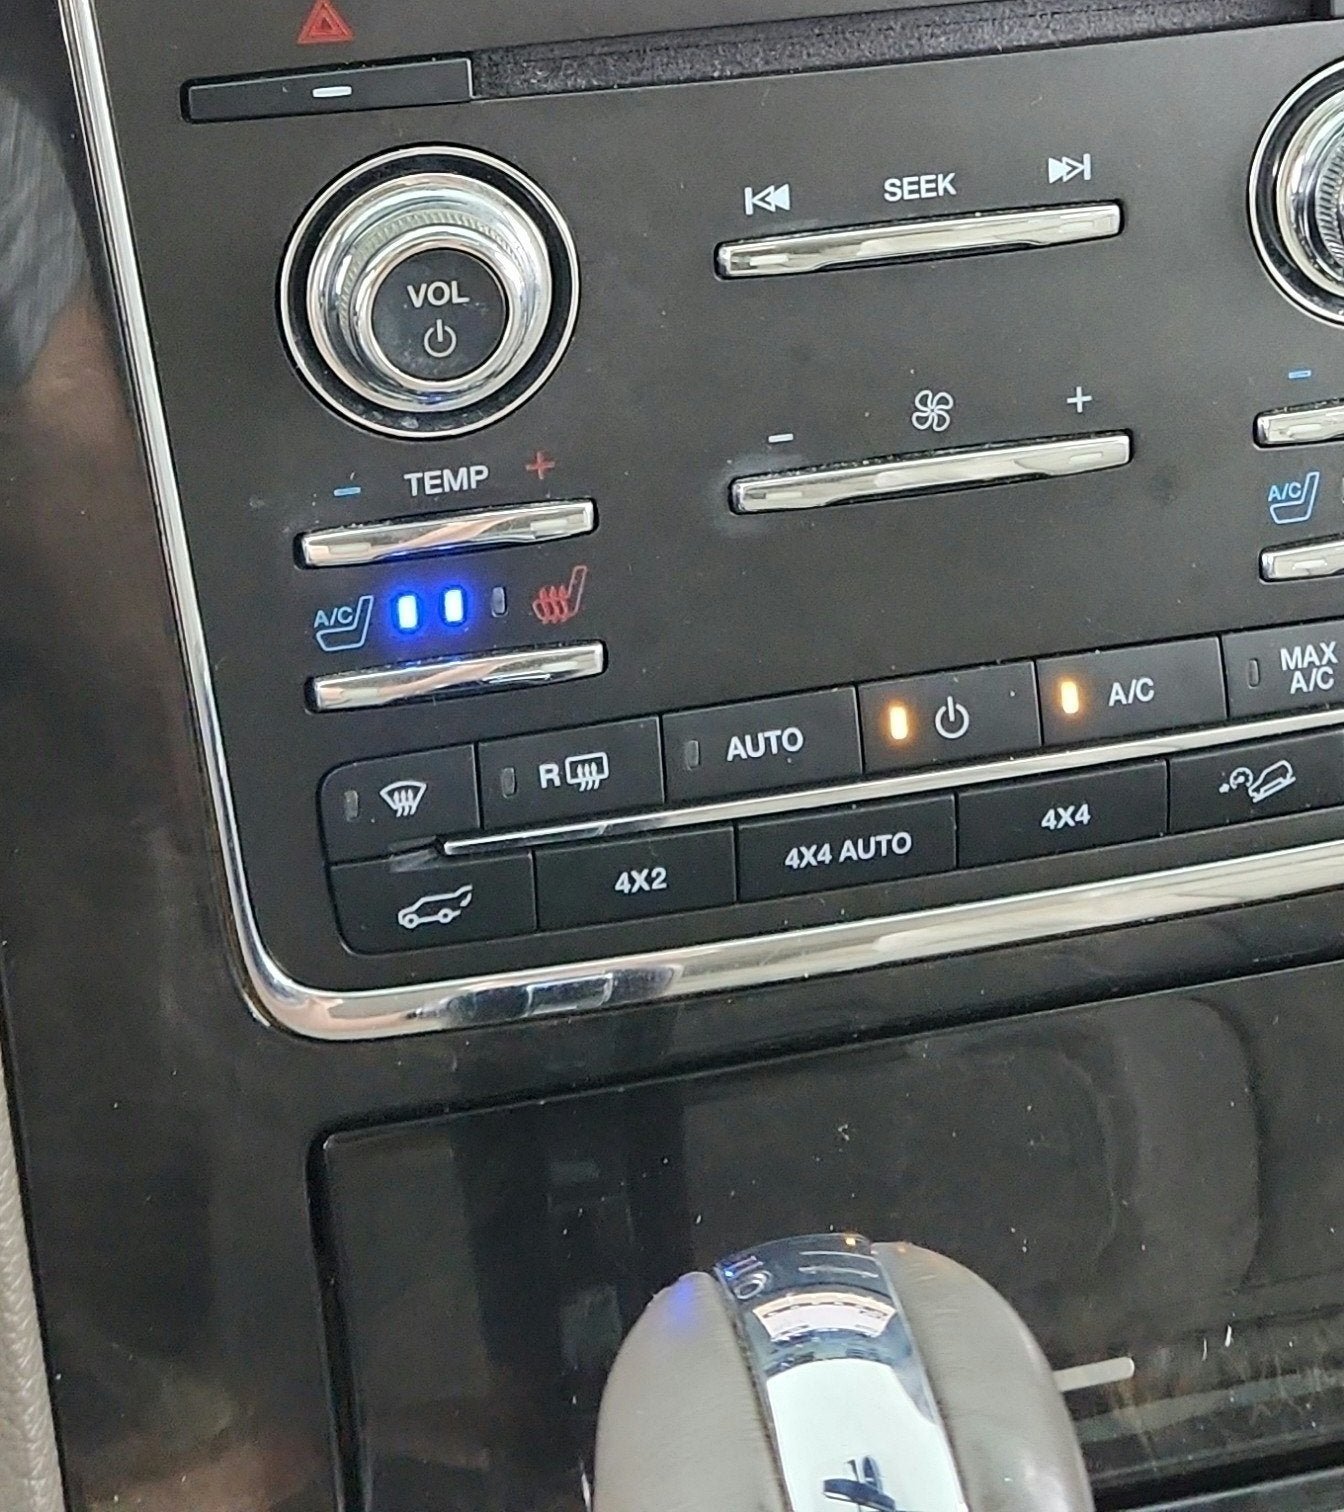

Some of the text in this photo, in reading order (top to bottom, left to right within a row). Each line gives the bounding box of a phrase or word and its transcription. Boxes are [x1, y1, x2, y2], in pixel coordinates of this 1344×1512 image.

[883, 172, 957, 202] SEEK
[406, 280, 470, 309] VOL
[403, 465, 490, 498] TEMP
[1267, 481, 1303, 503] A/C
[313, 605, 354, 629] A/C
[1279, 641, 1339, 672] MAX
[1107, 677, 1156, 707] A/C
[1289, 665, 1335, 695] A/C
[726, 726, 805, 763] AUTO
[539, 763, 561, 789] R
[1040, 803, 1092, 831] 4X4
[783, 830, 913, 870] 4X4 AUTO
[614, 867, 669, 895] 4X2
